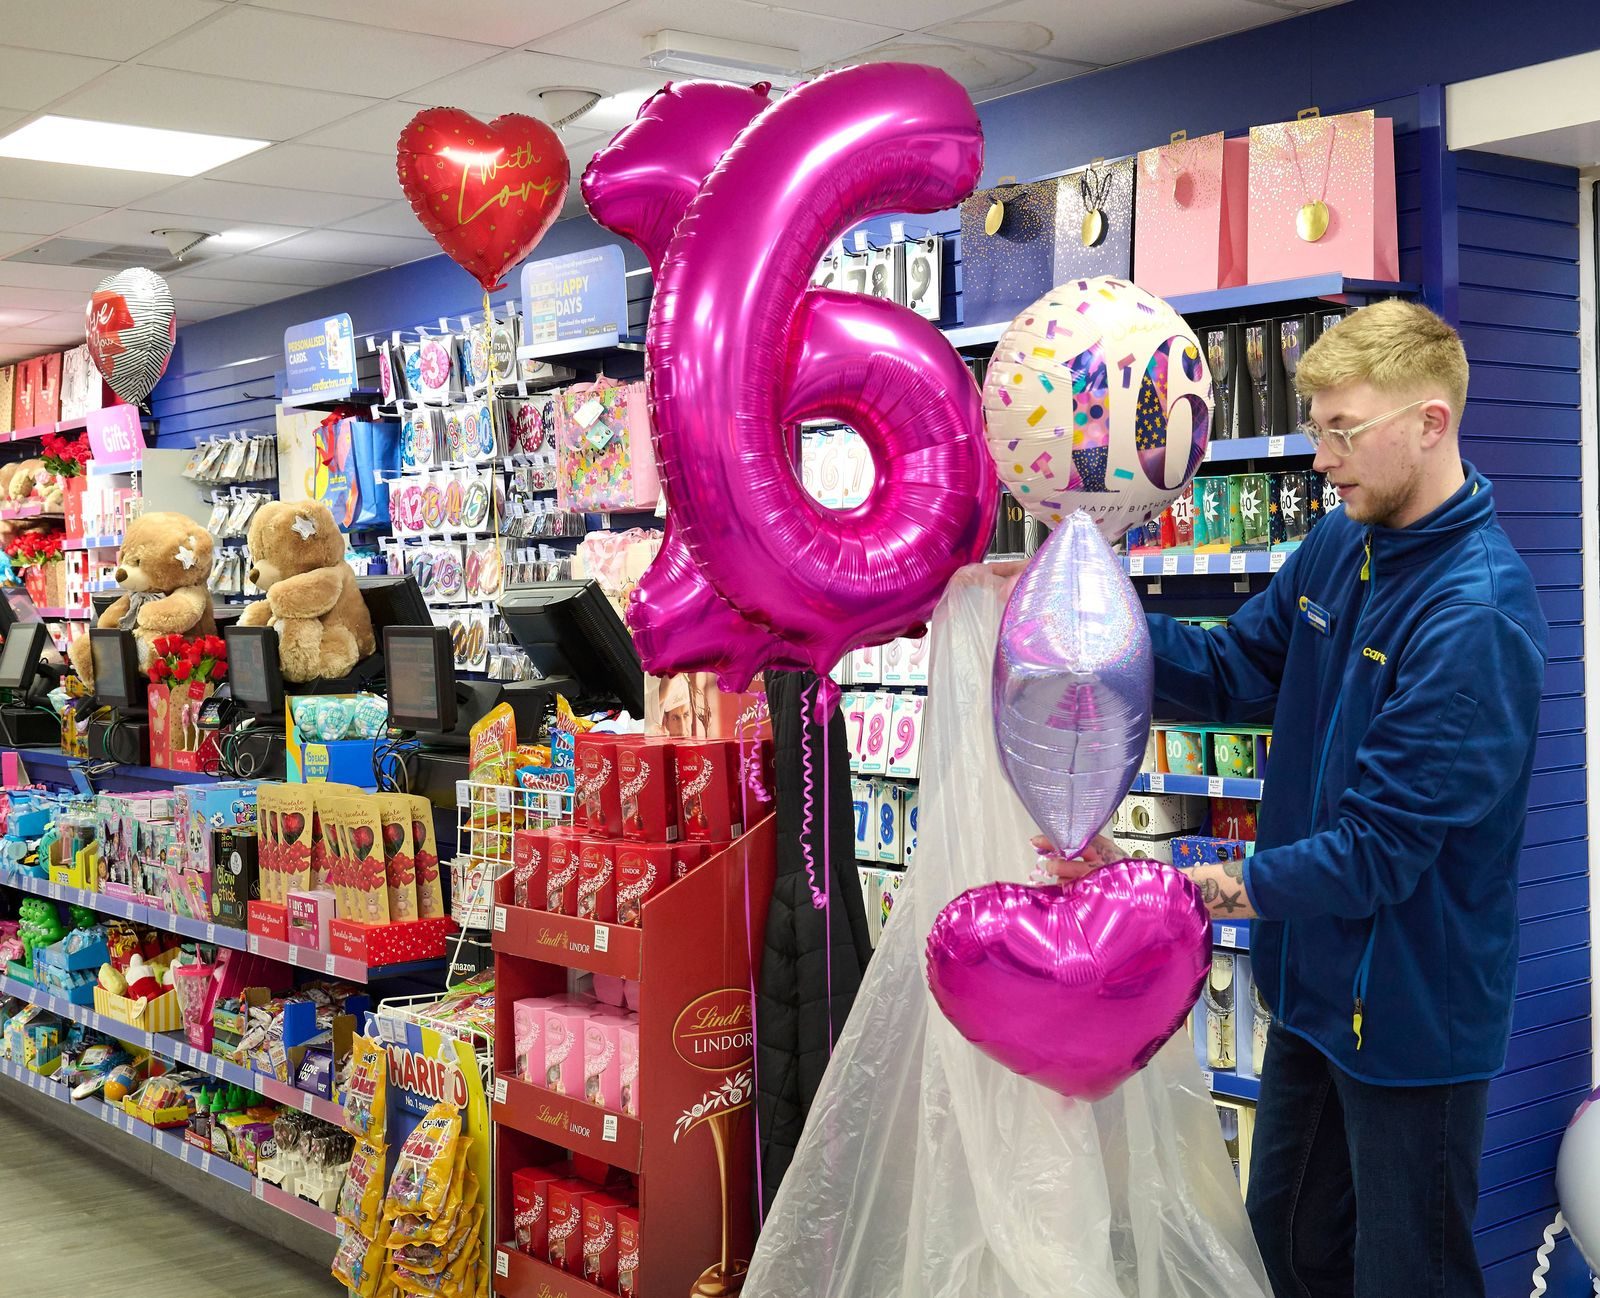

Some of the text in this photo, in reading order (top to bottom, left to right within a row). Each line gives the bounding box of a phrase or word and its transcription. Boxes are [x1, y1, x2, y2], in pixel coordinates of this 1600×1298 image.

[480, 142, 541, 185] With
[458, 176, 561, 225] Love
[927, 238, 934, 253] 9
[555, 275, 589, 297] HAPPY
[911, 256, 932, 303] 9
[556, 297, 583, 316] DAYS
[88, 302, 114, 335] ove
[427, 351, 440, 379] 3
[1055, 335, 1210, 494] 16
[103, 423, 131, 453] Gifts
[448, 422, 459, 449] 8
[466, 415, 476, 443] 9
[403, 493, 423, 524] 12
[464, 486, 482, 520] 15
[1281, 494, 1292, 510] 60
[1324, 491, 1336, 507] 60
[1176, 502, 1188, 518] 21
[914, 699, 922, 715] 9
[867, 712, 885, 757] 8
[894, 716, 915, 761] 9
[314, 754, 327, 762] EACH
[1167, 740, 1182, 758] 30
[1214, 744, 1229, 762] 40
[621, 765, 636, 773] LINDOR
[682, 764, 698, 772] LINDOR
[866, 783, 873, 799] 7
[892, 785, 898, 801] 8
[853, 801, 868, 841] 7
[880, 803, 894, 845] 8
[1226, 816, 1240, 841] 21
[551, 857, 565, 865] LINDOR
[583, 862, 598, 870] LINDOR
[217, 865, 235, 885] Glow
[622, 867, 640, 875] LINDOR
[292, 900, 304, 911] LOVE
[303, 902, 314, 914] YOU
[537, 928, 590, 954] Lindt LINDOR
[449, 962, 476, 972] amazon
[690, 1005, 745, 1030] Lindt
[694, 1032, 753, 1054] LINDOR
[299, 1071, 310, 1081] YOU
[304, 1063, 320, 1075] LOVE
[405, 1095, 414, 1106] No.
[414, 1099, 418, 1108] 1
[536, 1104, 591, 1138] Lindt LINDOR
[586, 1221, 600, 1231] LINDOR
